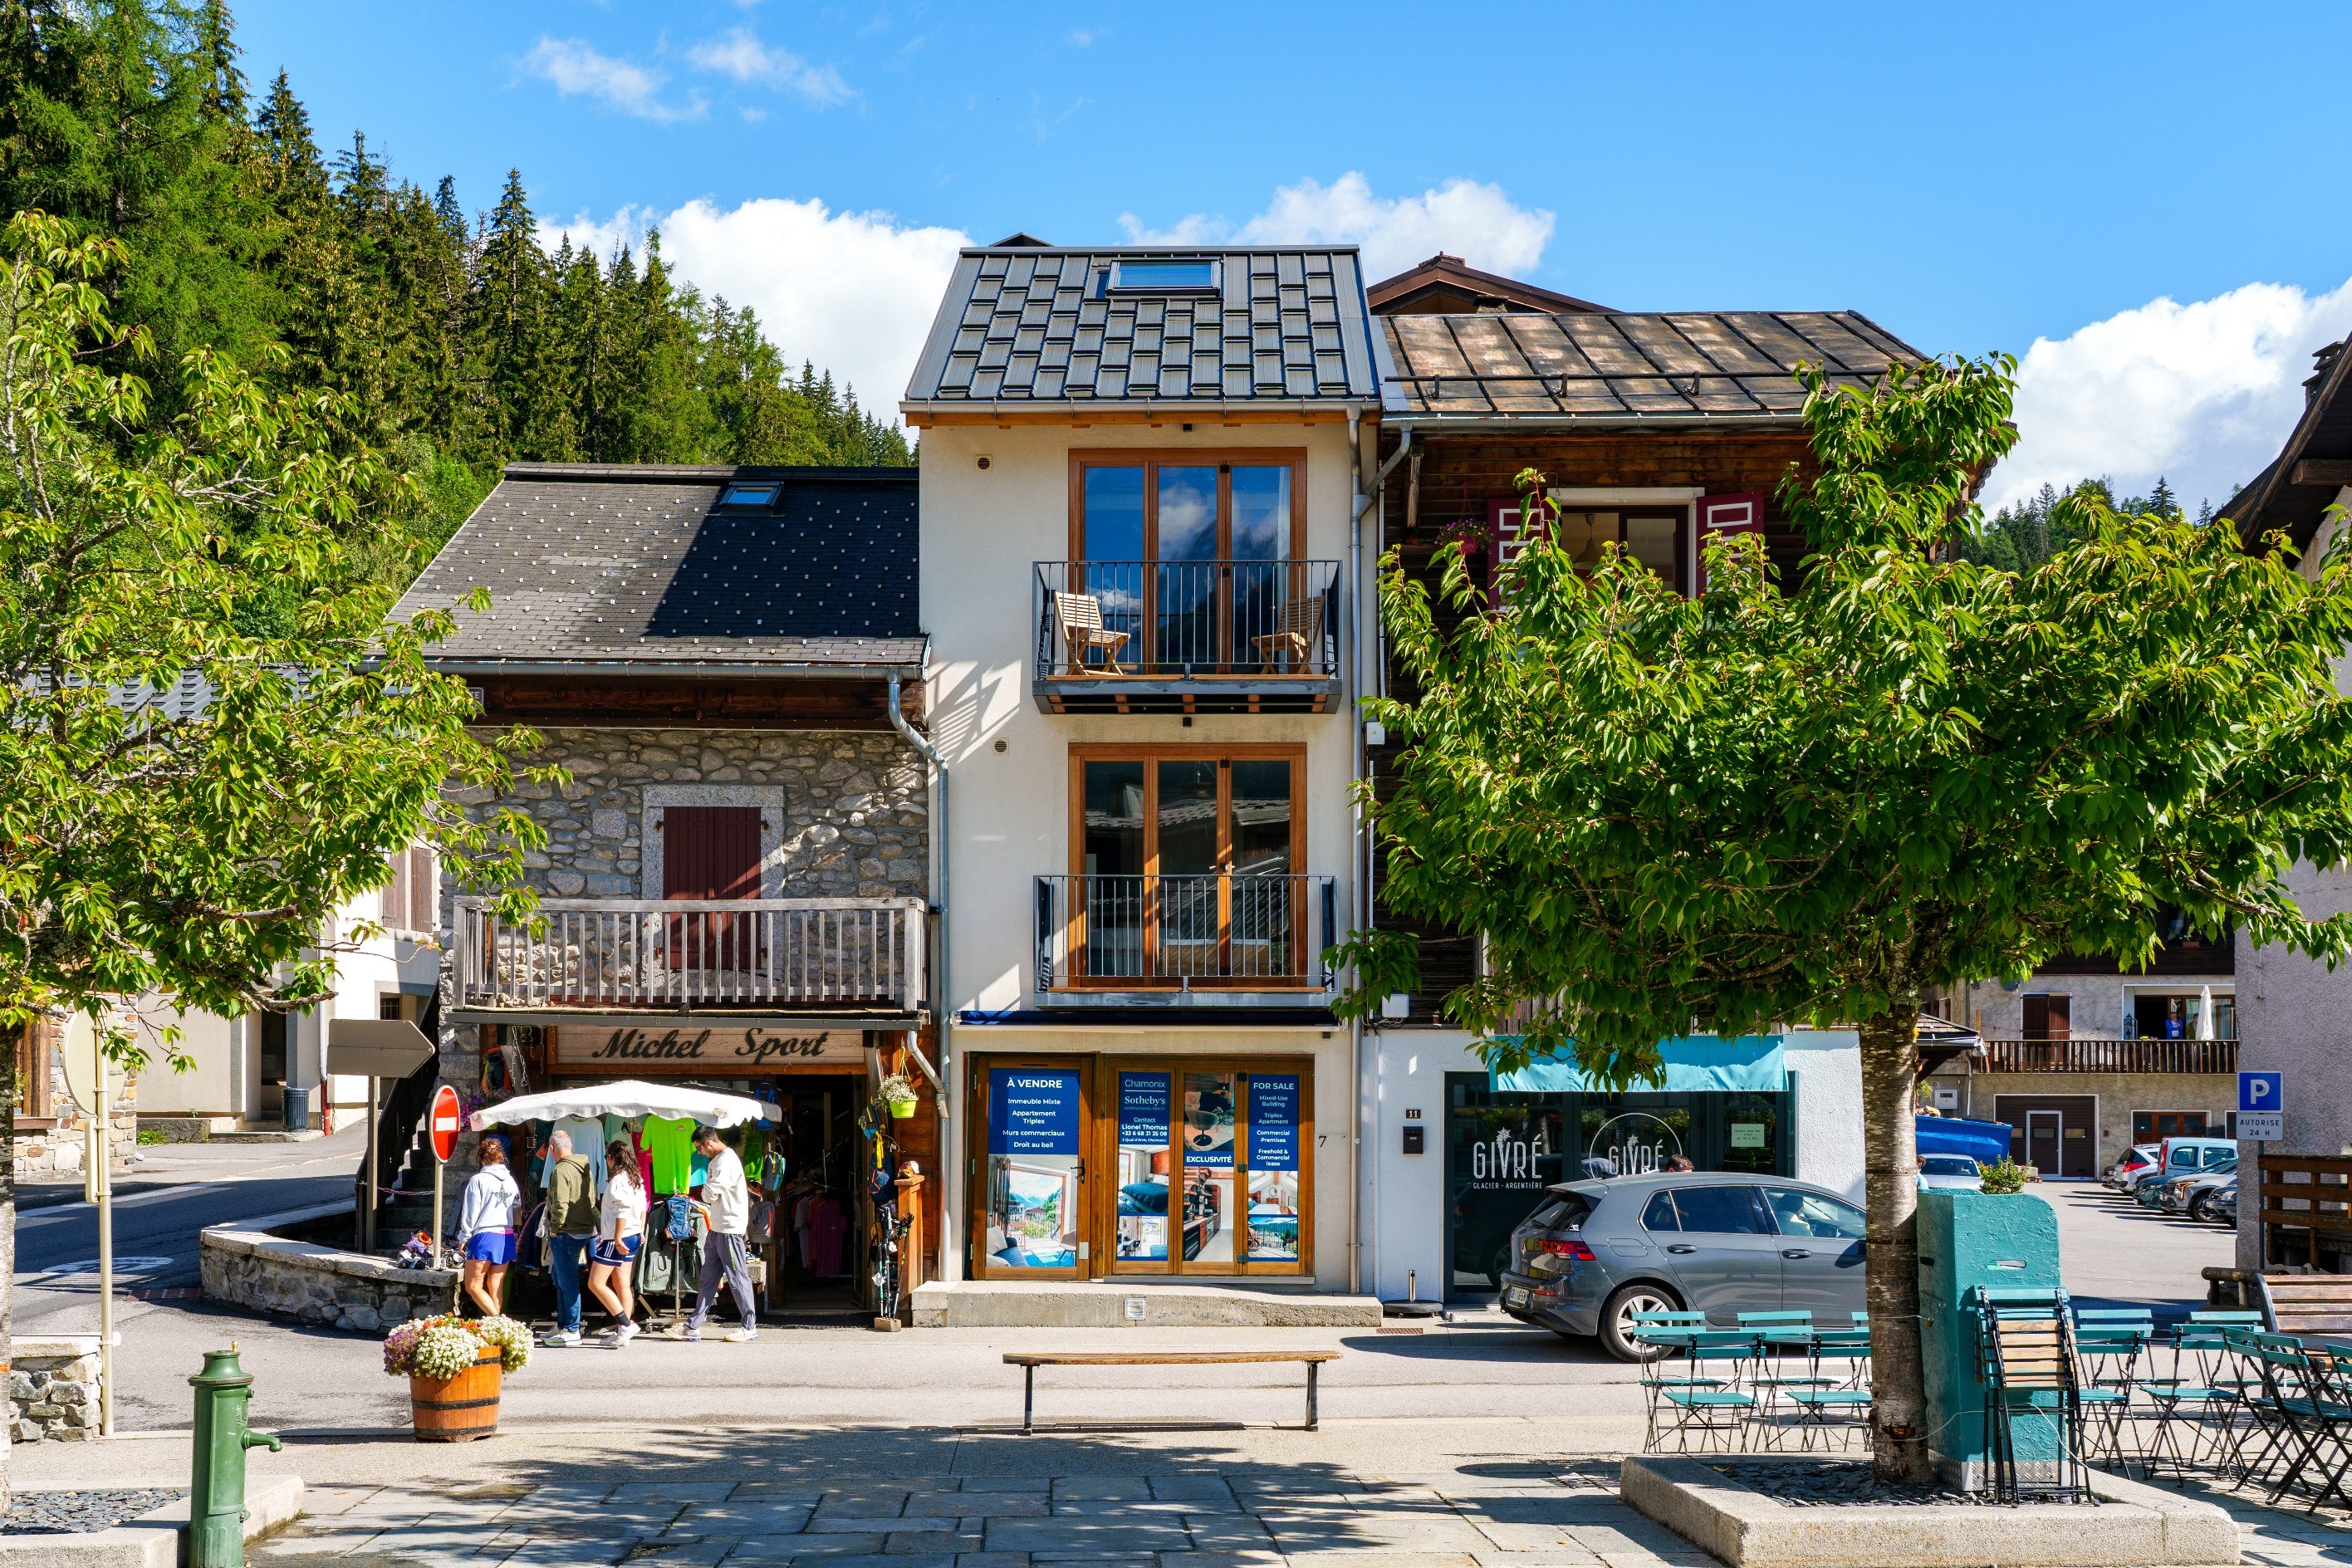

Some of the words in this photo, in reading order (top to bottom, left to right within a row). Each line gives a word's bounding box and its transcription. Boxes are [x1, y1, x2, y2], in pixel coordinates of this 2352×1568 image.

[591, 1028, 710, 1059] Michel
[734, 1027, 829, 1065] Sport
[1007, 1077, 1015, 1087] À
[1017, 1080, 1062, 1088] VENDRE
[2251, 1079, 2269, 1104] P
[1125, 1095, 1165, 1105] Sotheby's
[1319, 1136, 1327, 1148] 7
[1473, 1129, 1541, 1178] GIVRÉ
[1609, 1138, 1663, 1175] GIVRÉ
